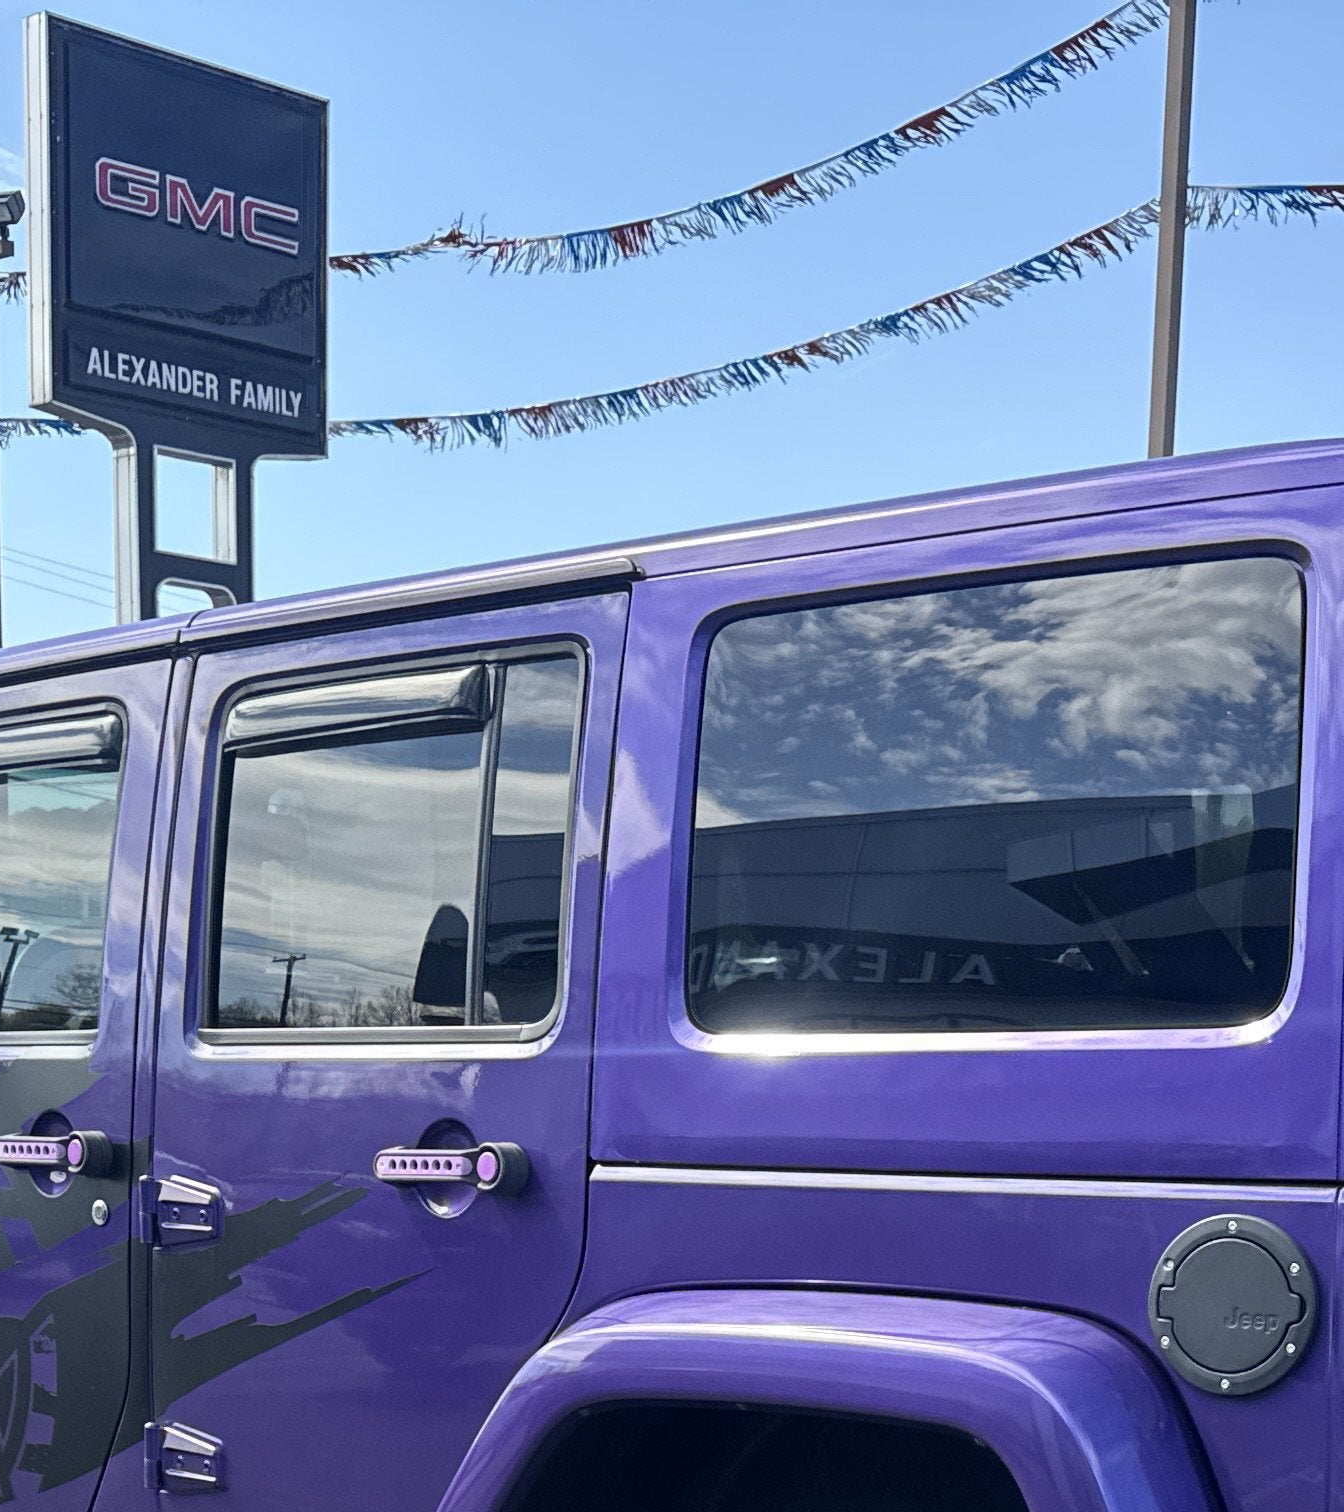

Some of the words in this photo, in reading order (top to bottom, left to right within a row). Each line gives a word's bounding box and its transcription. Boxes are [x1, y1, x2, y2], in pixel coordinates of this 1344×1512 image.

[94, 156, 300, 256] GMC
[86, 346, 219, 403] ALEXANDER
[230, 377, 302, 418] FAMILY
[1223, 1306, 1280, 1334] Jeep
